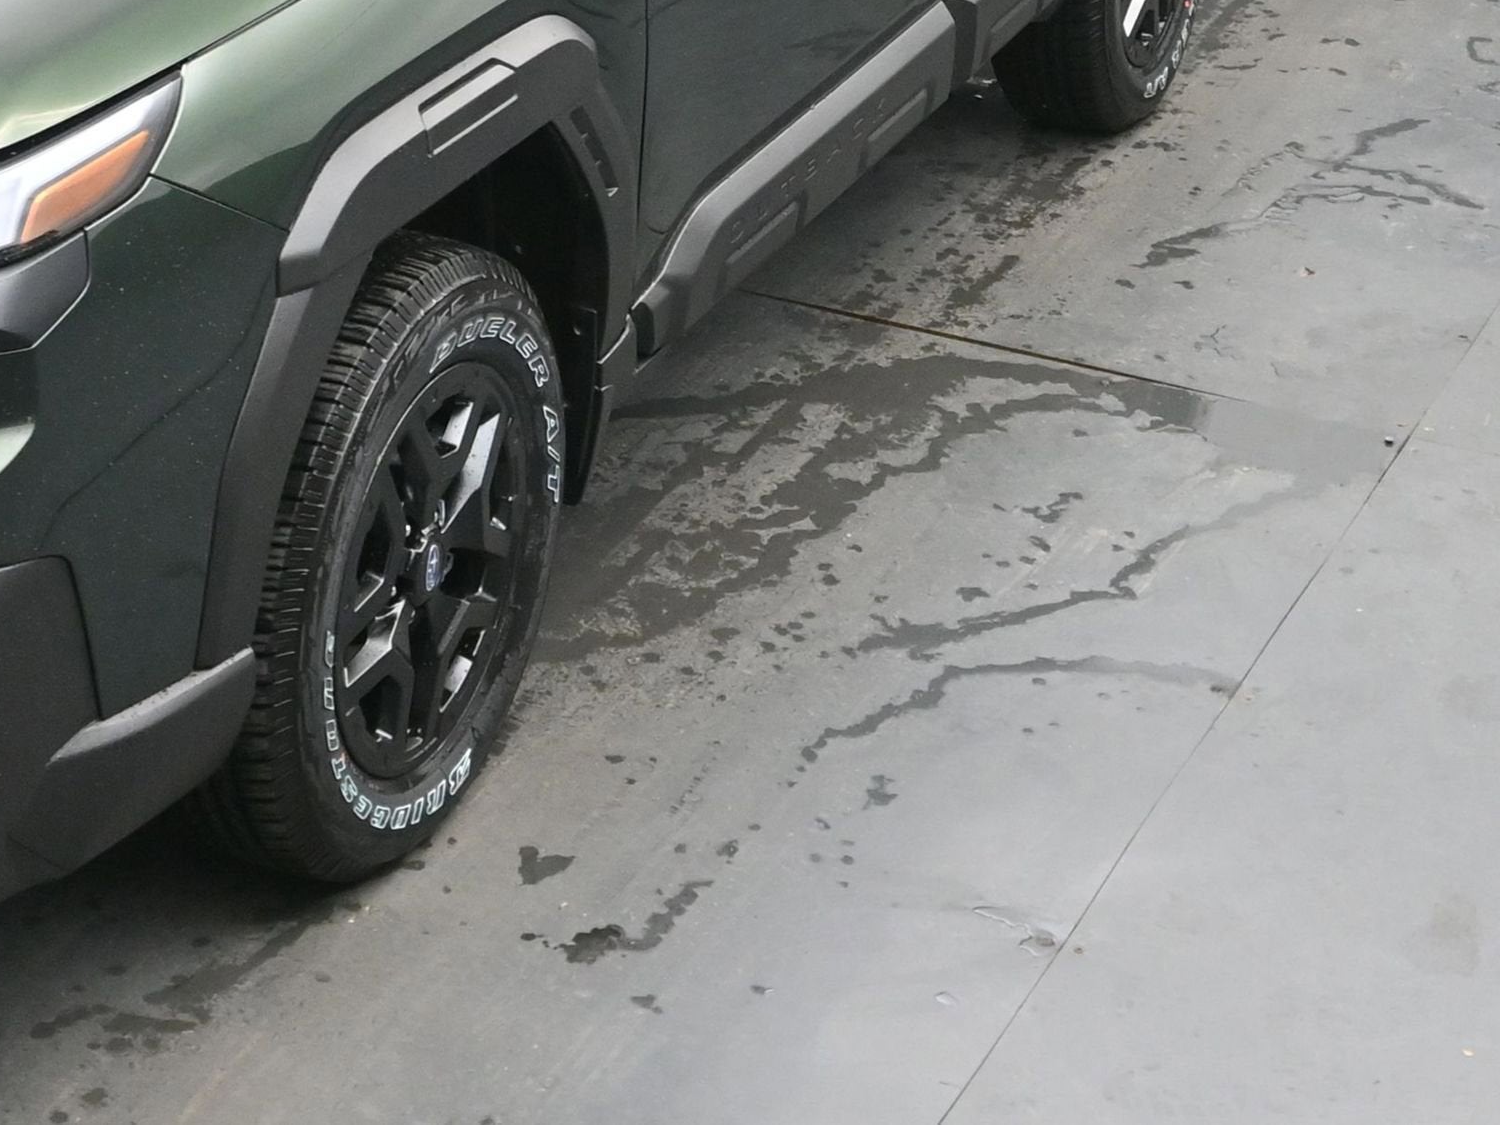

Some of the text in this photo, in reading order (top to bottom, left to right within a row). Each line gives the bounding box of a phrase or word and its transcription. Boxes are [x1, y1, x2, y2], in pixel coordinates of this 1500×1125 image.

[428, 316, 561, 504] DUELER A/T
[323, 629, 472, 831] BRIDGESTONE
